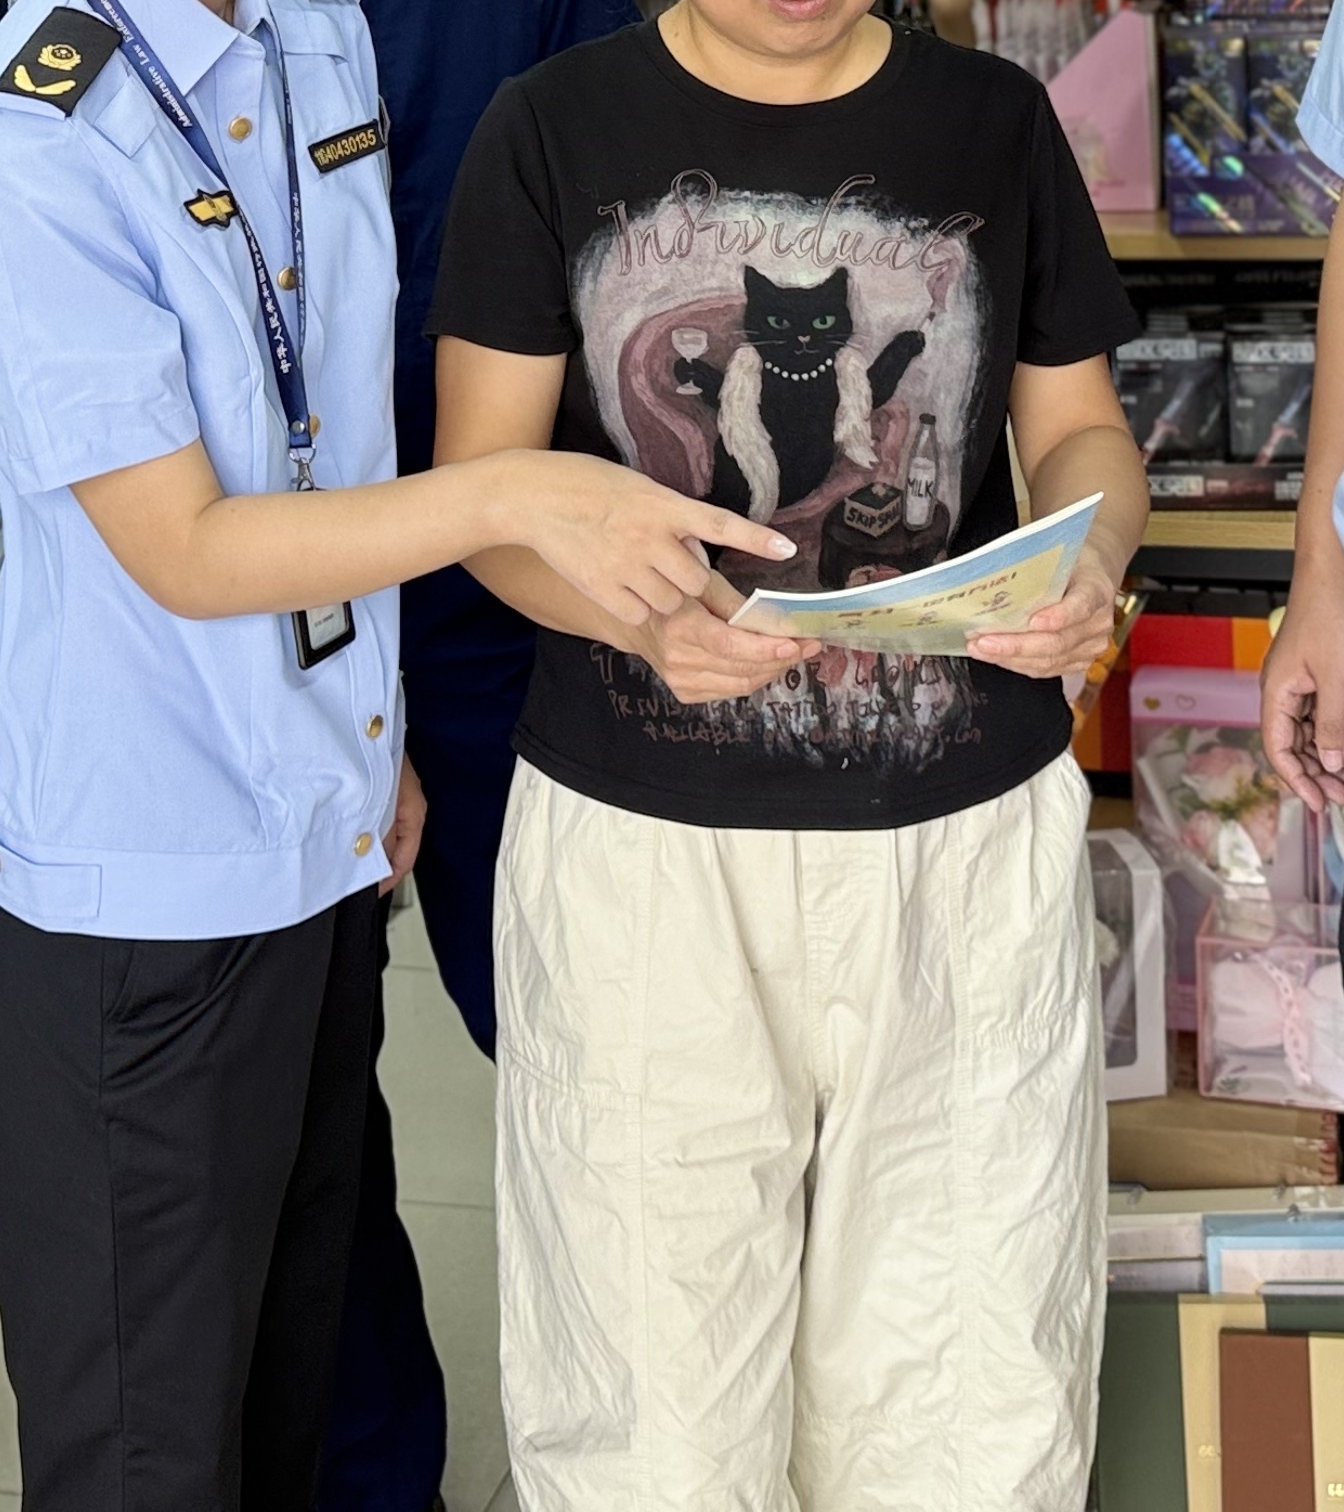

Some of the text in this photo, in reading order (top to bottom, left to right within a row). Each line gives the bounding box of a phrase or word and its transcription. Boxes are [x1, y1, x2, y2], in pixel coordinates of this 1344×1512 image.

[132, 43, 151, 66] Law
[596, 168, 985, 276] Individual
[907, 476, 934, 501] MILK
